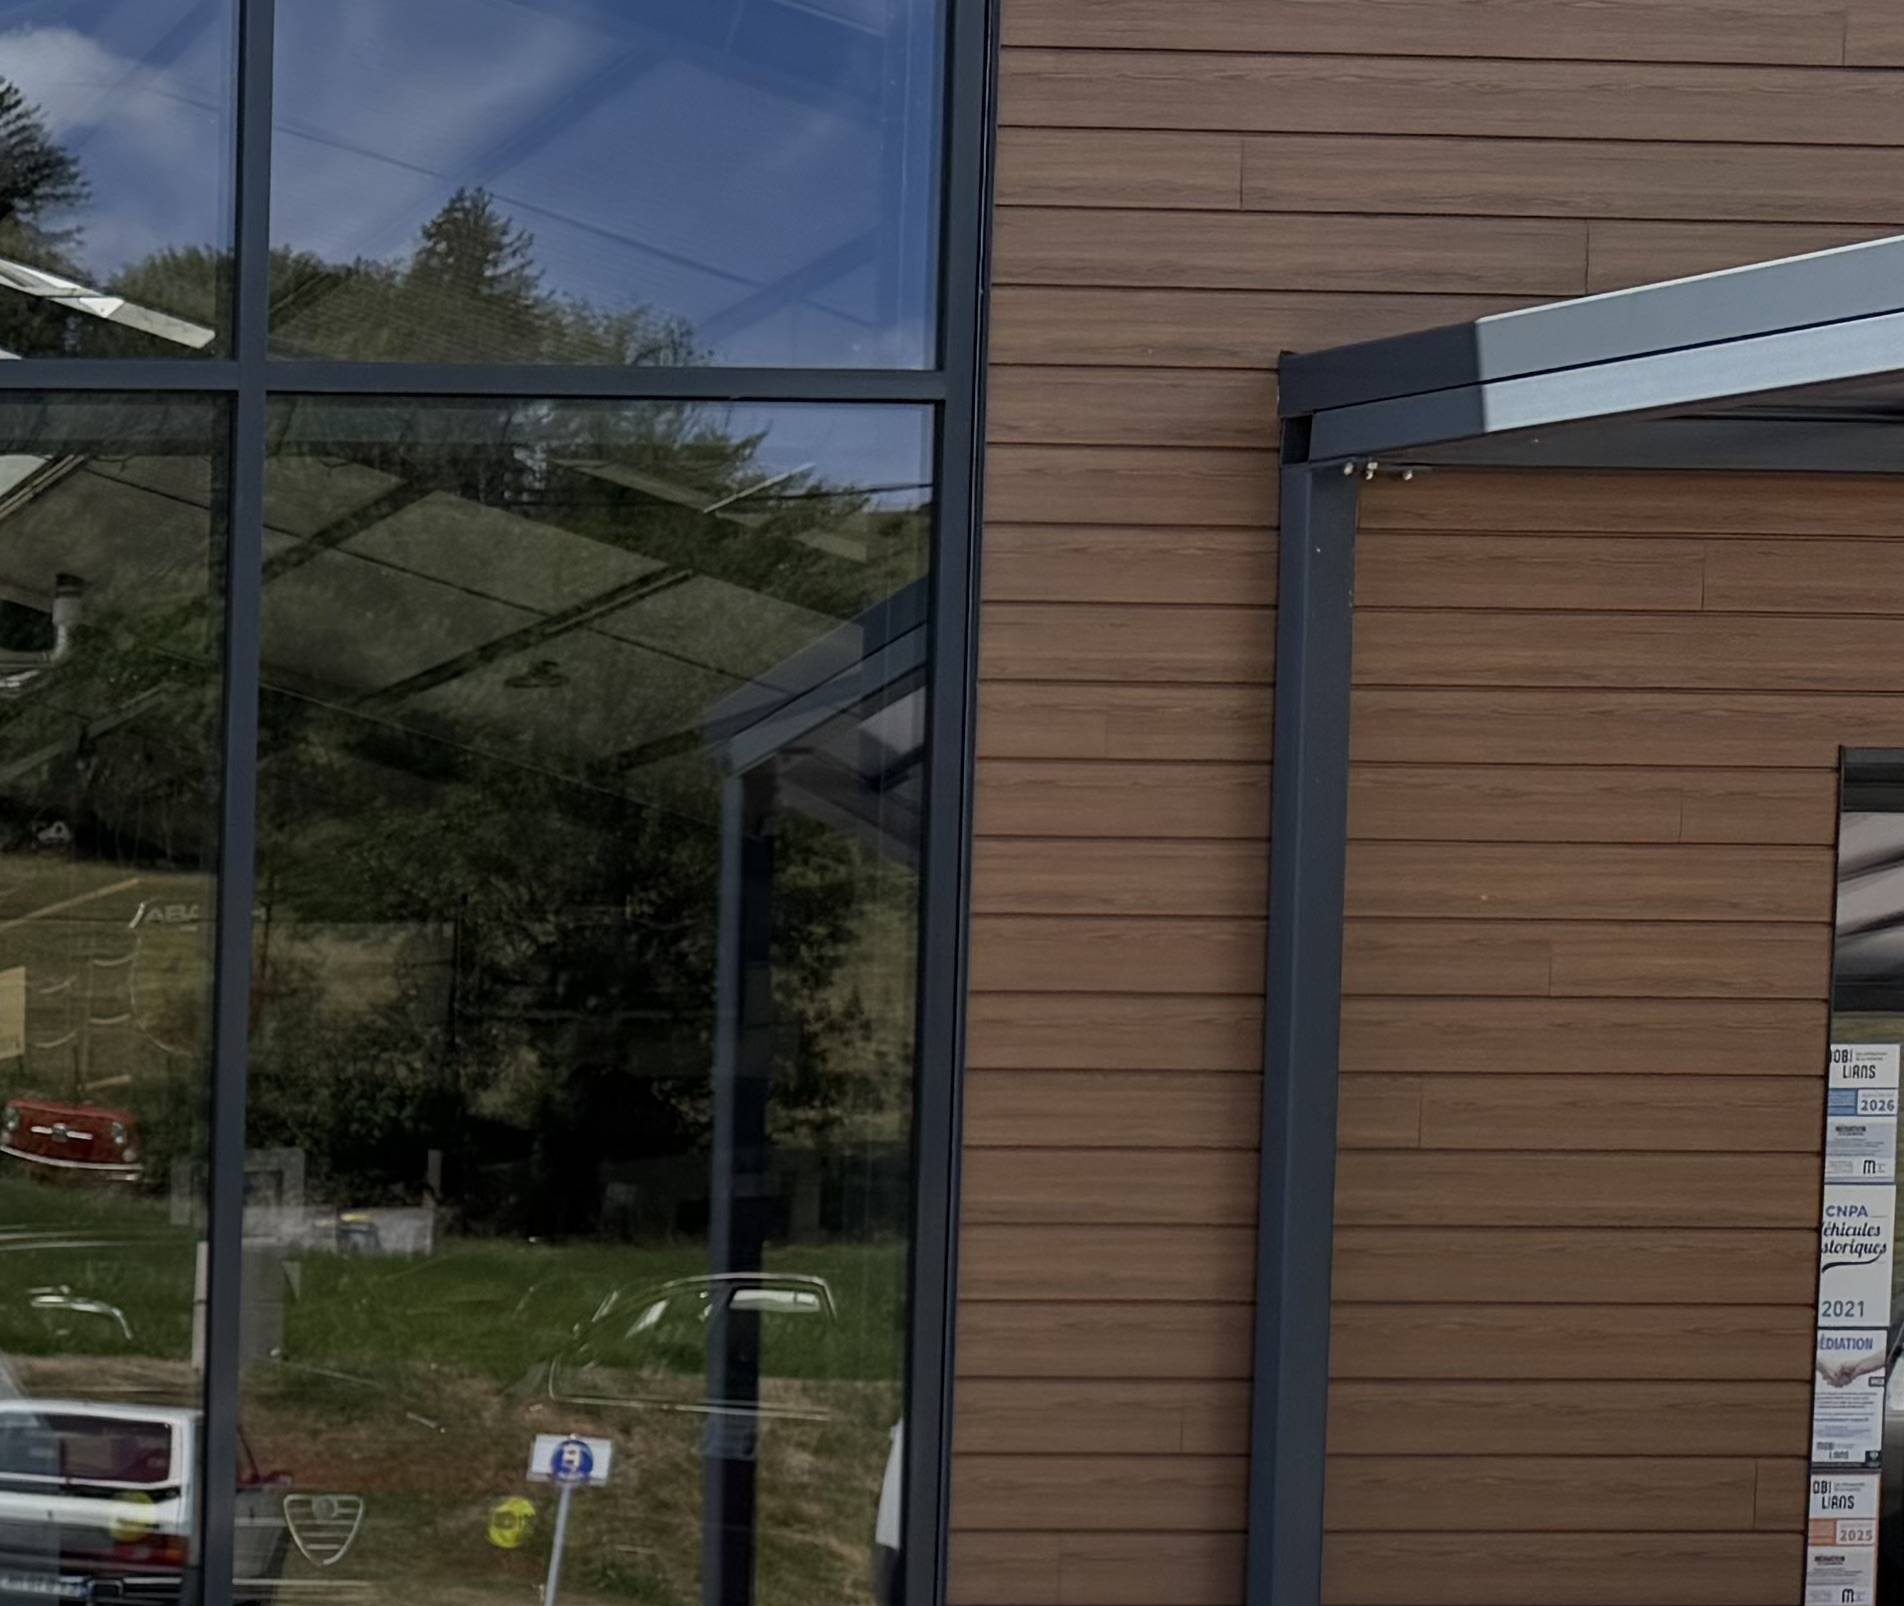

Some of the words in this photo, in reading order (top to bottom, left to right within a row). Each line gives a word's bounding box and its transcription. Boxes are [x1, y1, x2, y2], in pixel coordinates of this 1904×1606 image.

[1830, 1049, 1852, 1063] OBI
[1861, 1100, 1895, 1111] 2026
[1825, 1205, 1868, 1217] CNPA
[1822, 1221, 1880, 1237] éhicules
[1821, 1239, 1887, 1258] storiques
[1821, 1301, 1865, 1317] 2021
[1819, 1334, 1873, 1350] ÉDIATION
[1840, 1530, 1873, 1541] 2025
